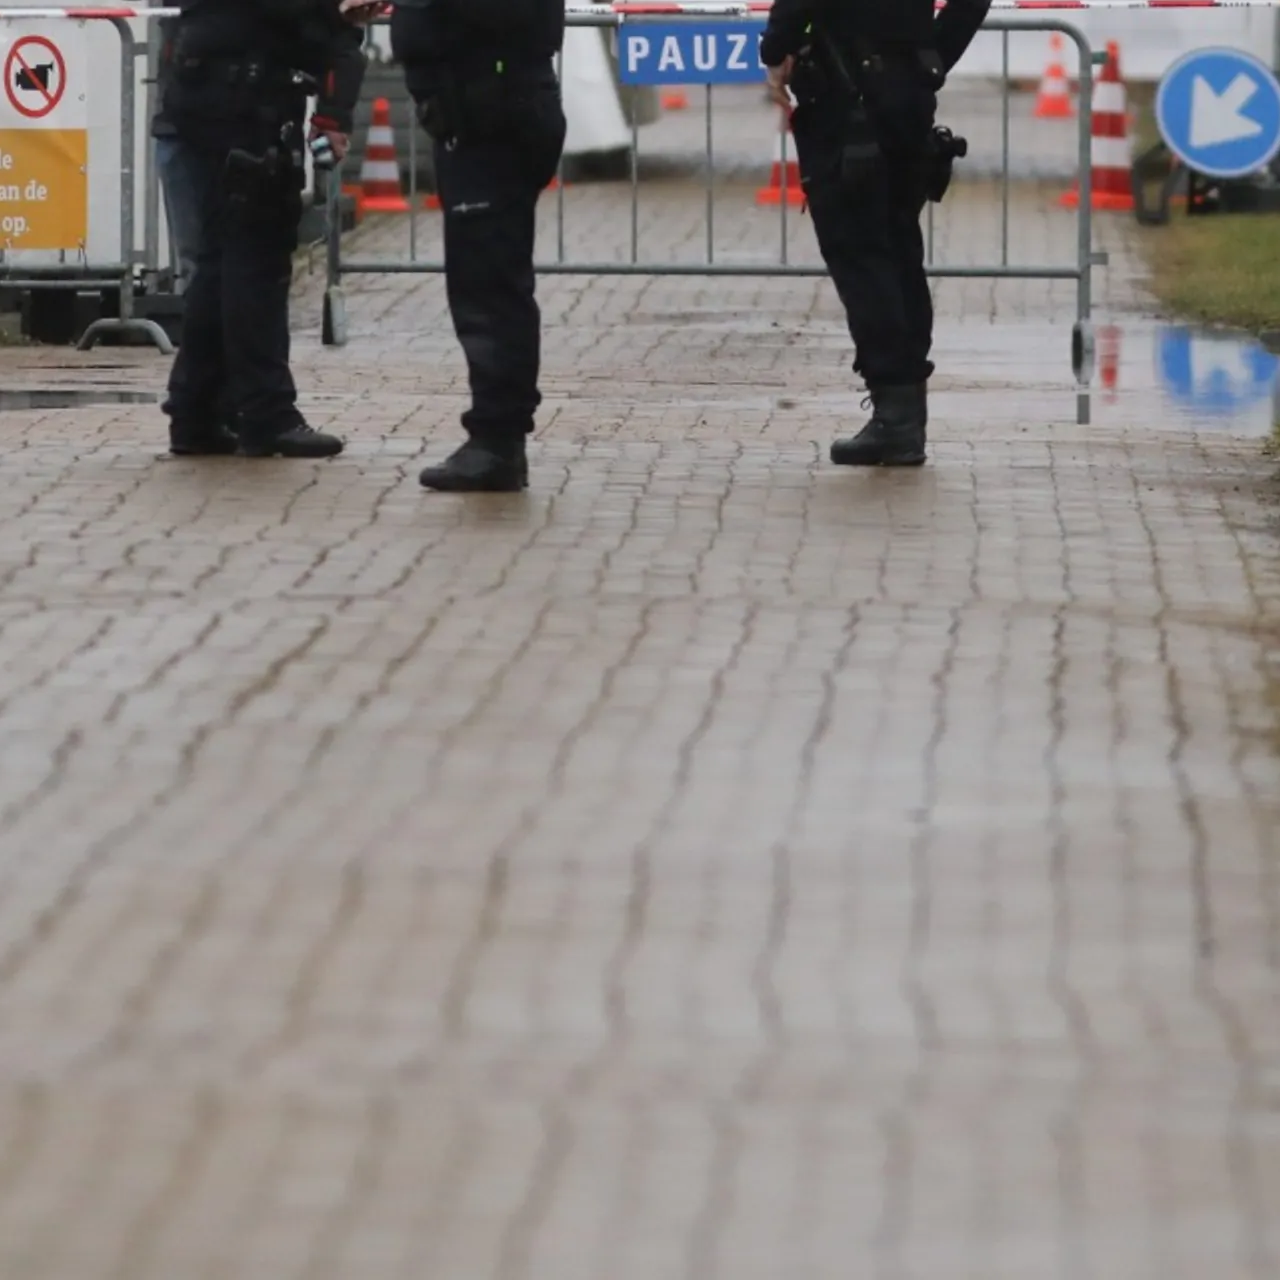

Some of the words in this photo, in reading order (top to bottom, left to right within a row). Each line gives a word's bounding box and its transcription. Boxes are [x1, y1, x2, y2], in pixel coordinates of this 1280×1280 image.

[627, 34, 768, 71] PAUZ
[24, 180, 47, 201] de
[2, 214, 30, 236] op.
